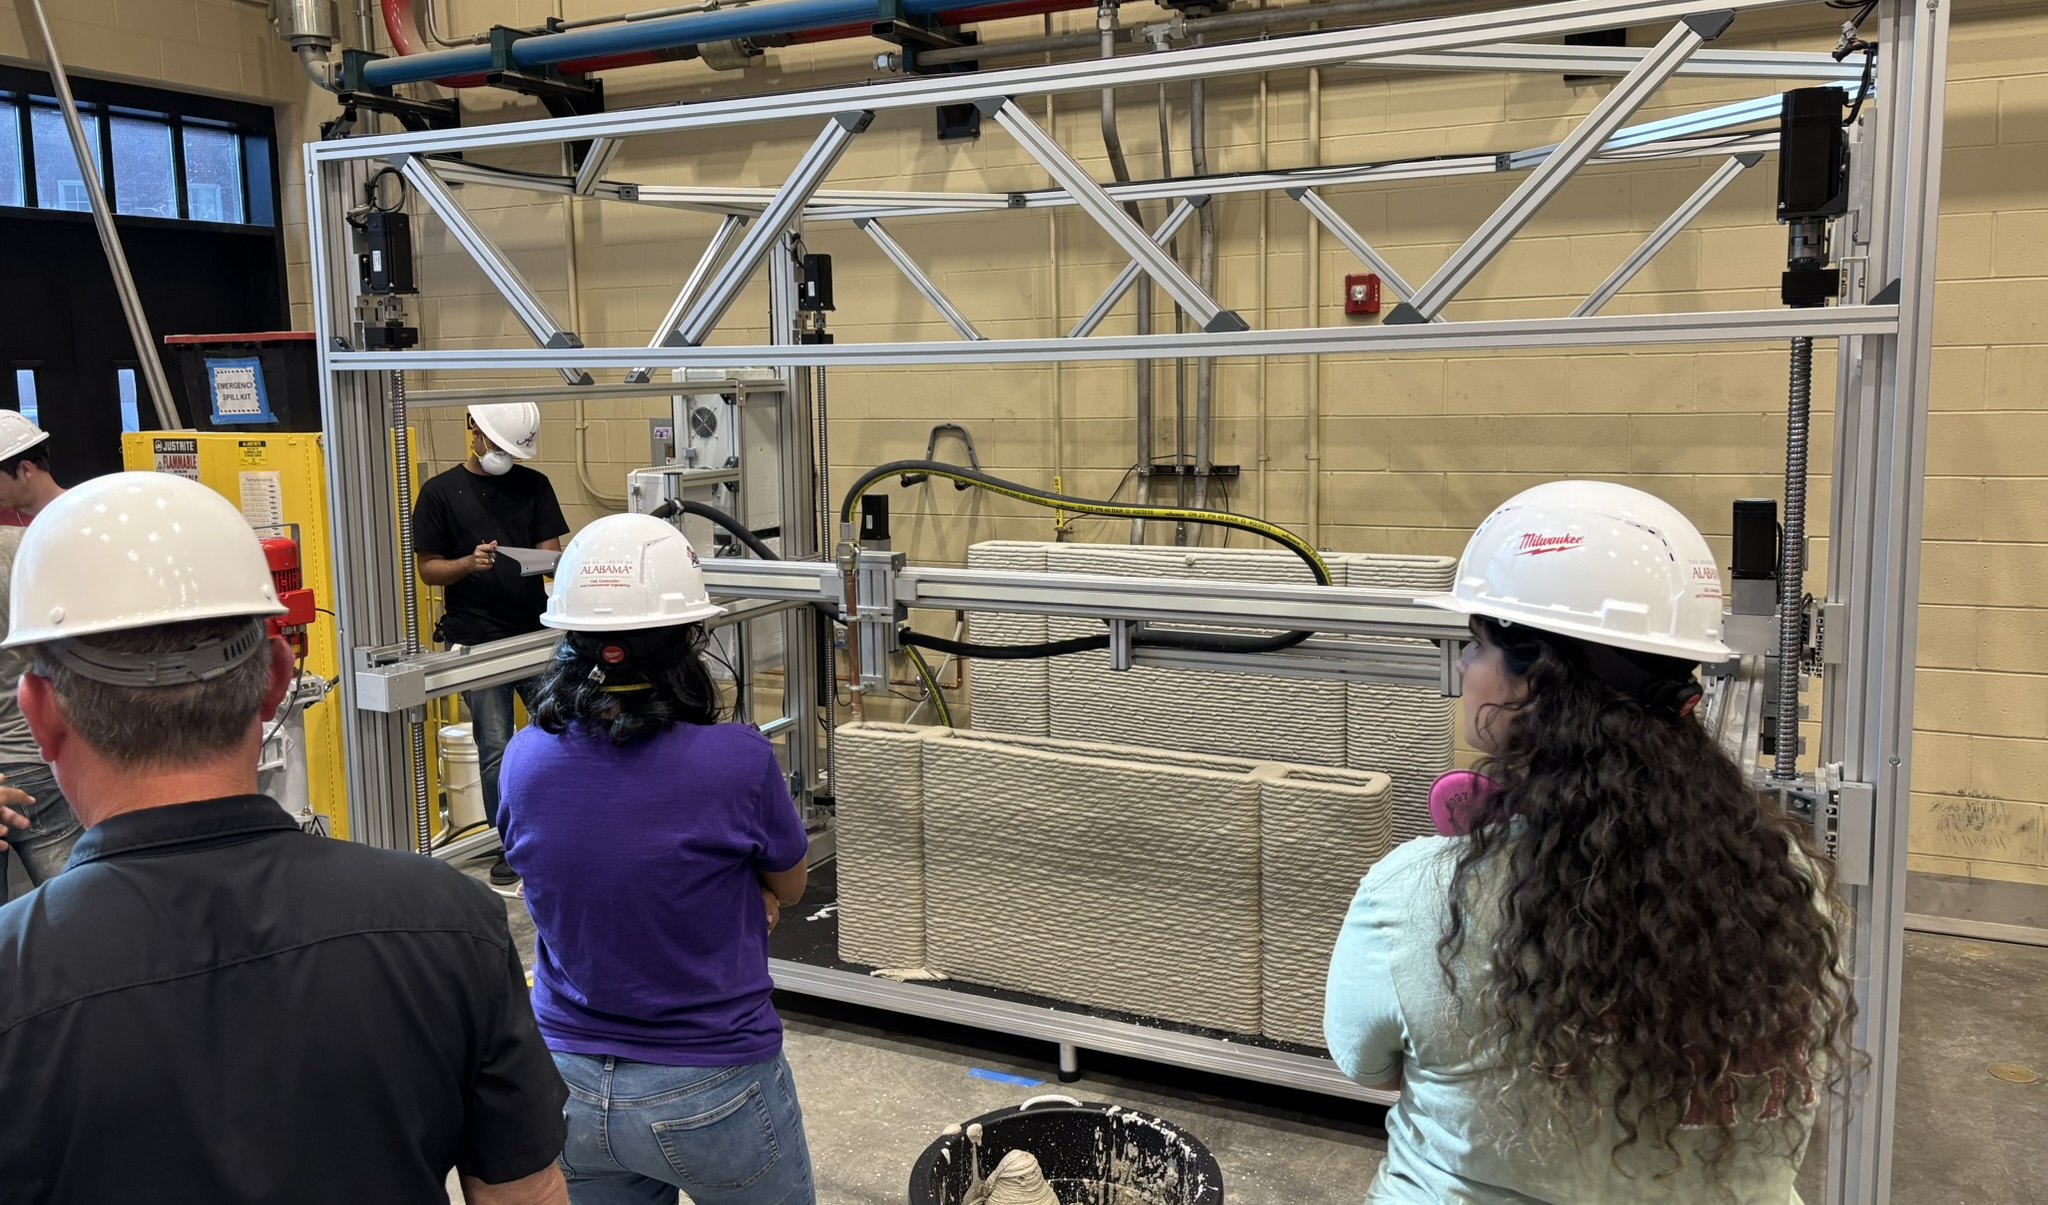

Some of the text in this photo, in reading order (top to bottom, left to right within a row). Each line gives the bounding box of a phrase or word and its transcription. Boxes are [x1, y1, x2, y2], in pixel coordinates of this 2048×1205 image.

[222, 393, 252, 401] SPILL KIT
[163, 440, 195, 451] JUSTRITE
[162, 454, 197, 470] FLAMMABLE
[1225, 515, 1239, 523] BAR
[1519, 532, 1583, 550] Milwaukee
[580, 565, 630, 575] ALABAMA
